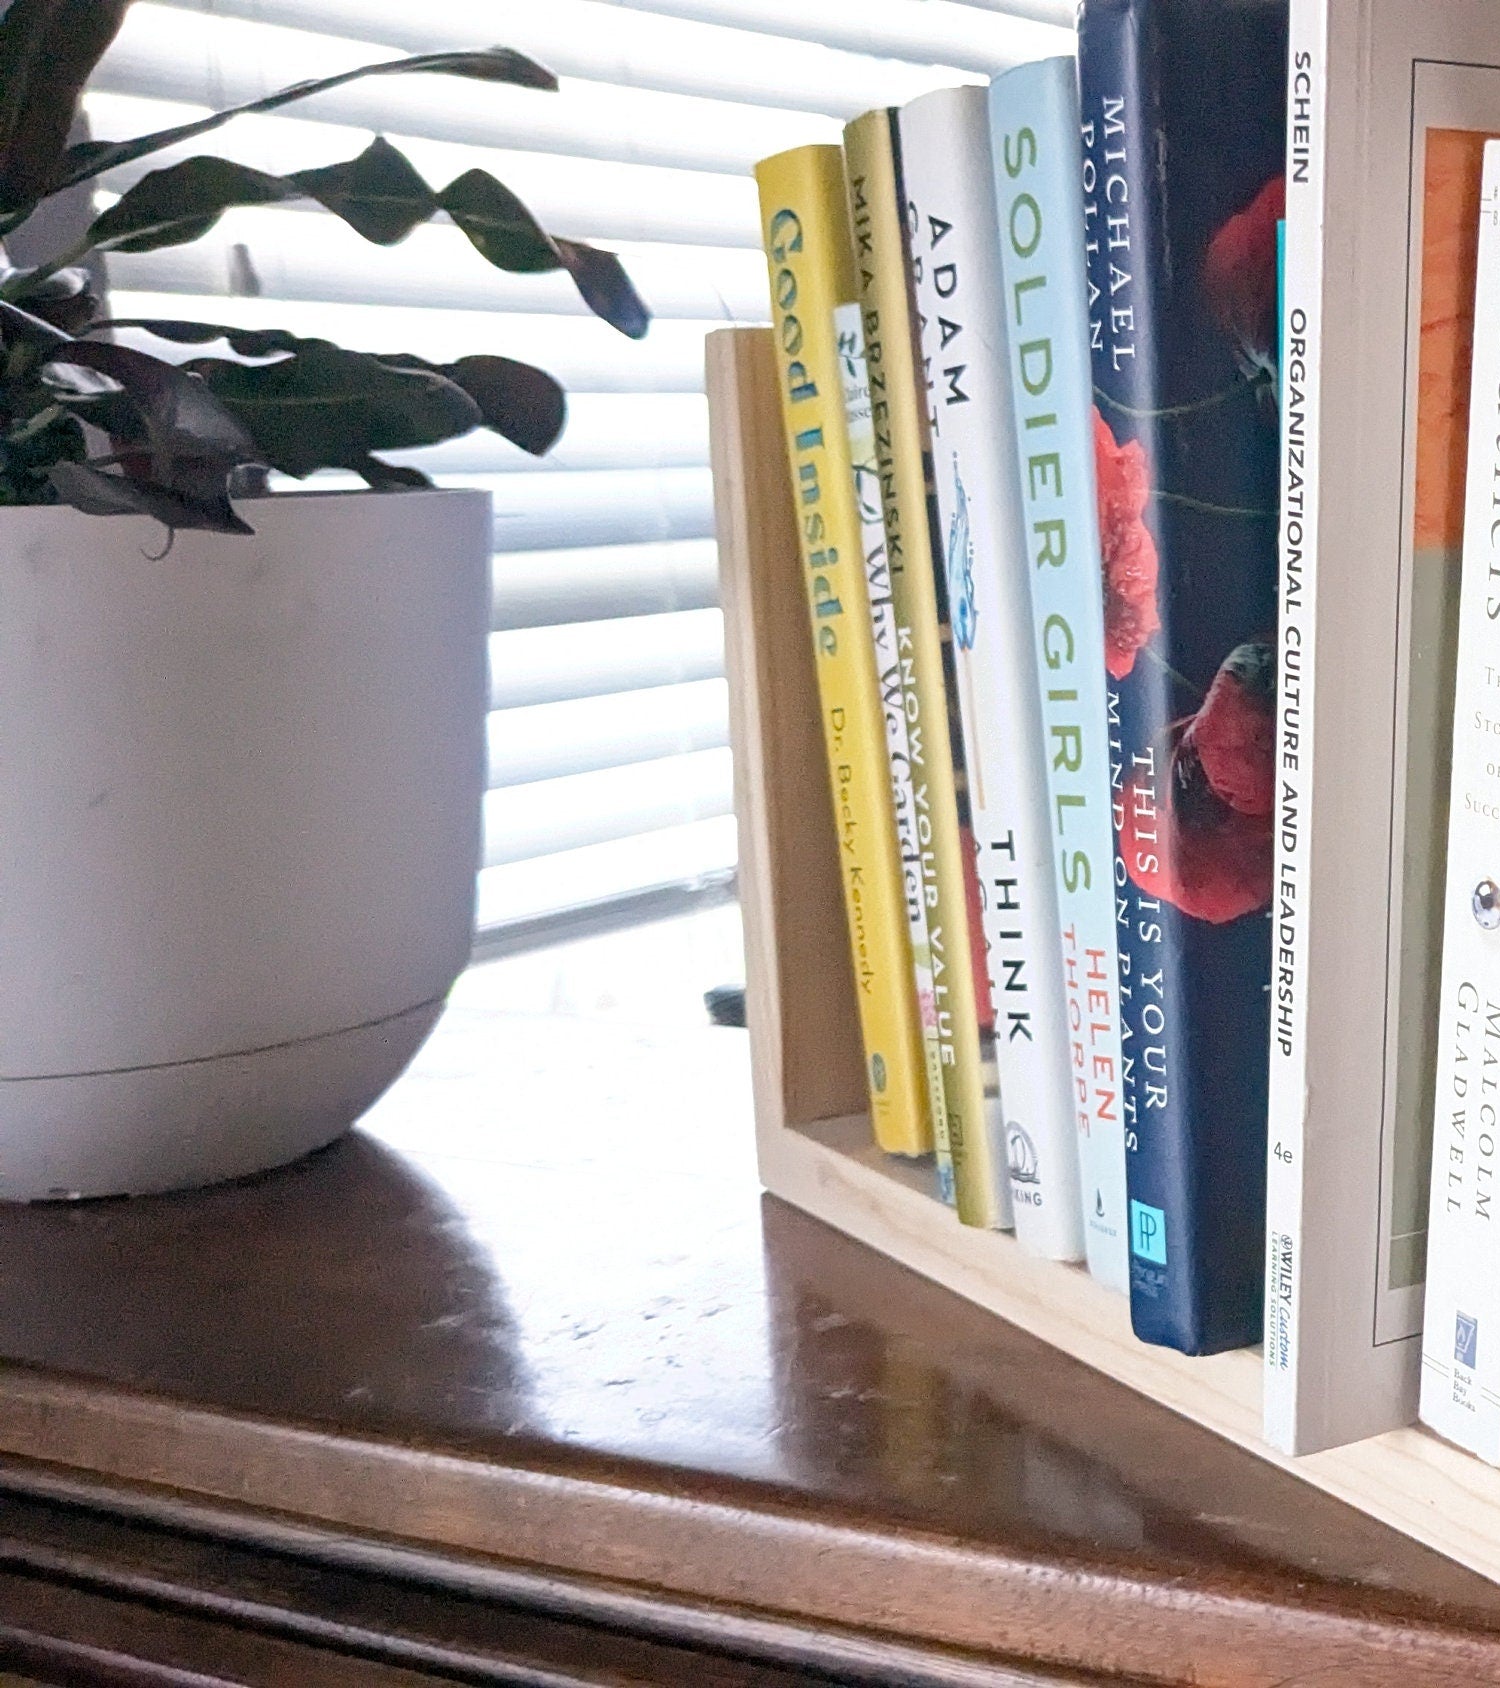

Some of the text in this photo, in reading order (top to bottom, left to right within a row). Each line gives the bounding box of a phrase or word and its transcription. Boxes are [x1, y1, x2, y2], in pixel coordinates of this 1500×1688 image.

[853, 175, 875, 291] MIKA
[1292, 50, 1312, 184] SCHEIN
[927, 214, 971, 406] ADAM
[1081, 119, 1104, 352] POLLAN
[1102, 95, 1136, 372] MICHAEL
[770, 208, 844, 657] Good Inside
[1003, 126, 1092, 895] SOLDIER GIRLS
[866, 544, 921, 922] Why We Garden
[1276, 308, 1307, 1057] ORGANIZATIONAL CULTURE AND LEADERSHIP
[830, 707, 875, 995] Dr. Becky Kennedy
[898, 627, 925, 766] KNOW
[914, 784, 939, 909] YOUR
[930, 925, 956, 1066] VALUE
[990, 829, 1033, 1043] THINK
[1107, 691, 1138, 1152] MIND ON PLANTS
[1132, 746, 1168, 1110] THIS IS YOUR
[1062, 922, 1090, 1138] THORPE
[1085, 948, 1117, 1122] HELEN
[1446, 981, 1480, 1213] GLADWELL
[1273, 1142, 1293, 1164] 4e
[1268, 1231, 1279, 1367] LEARNING SOLUTIONS
[1279, 1250, 1293, 1371] WILEY Custom
